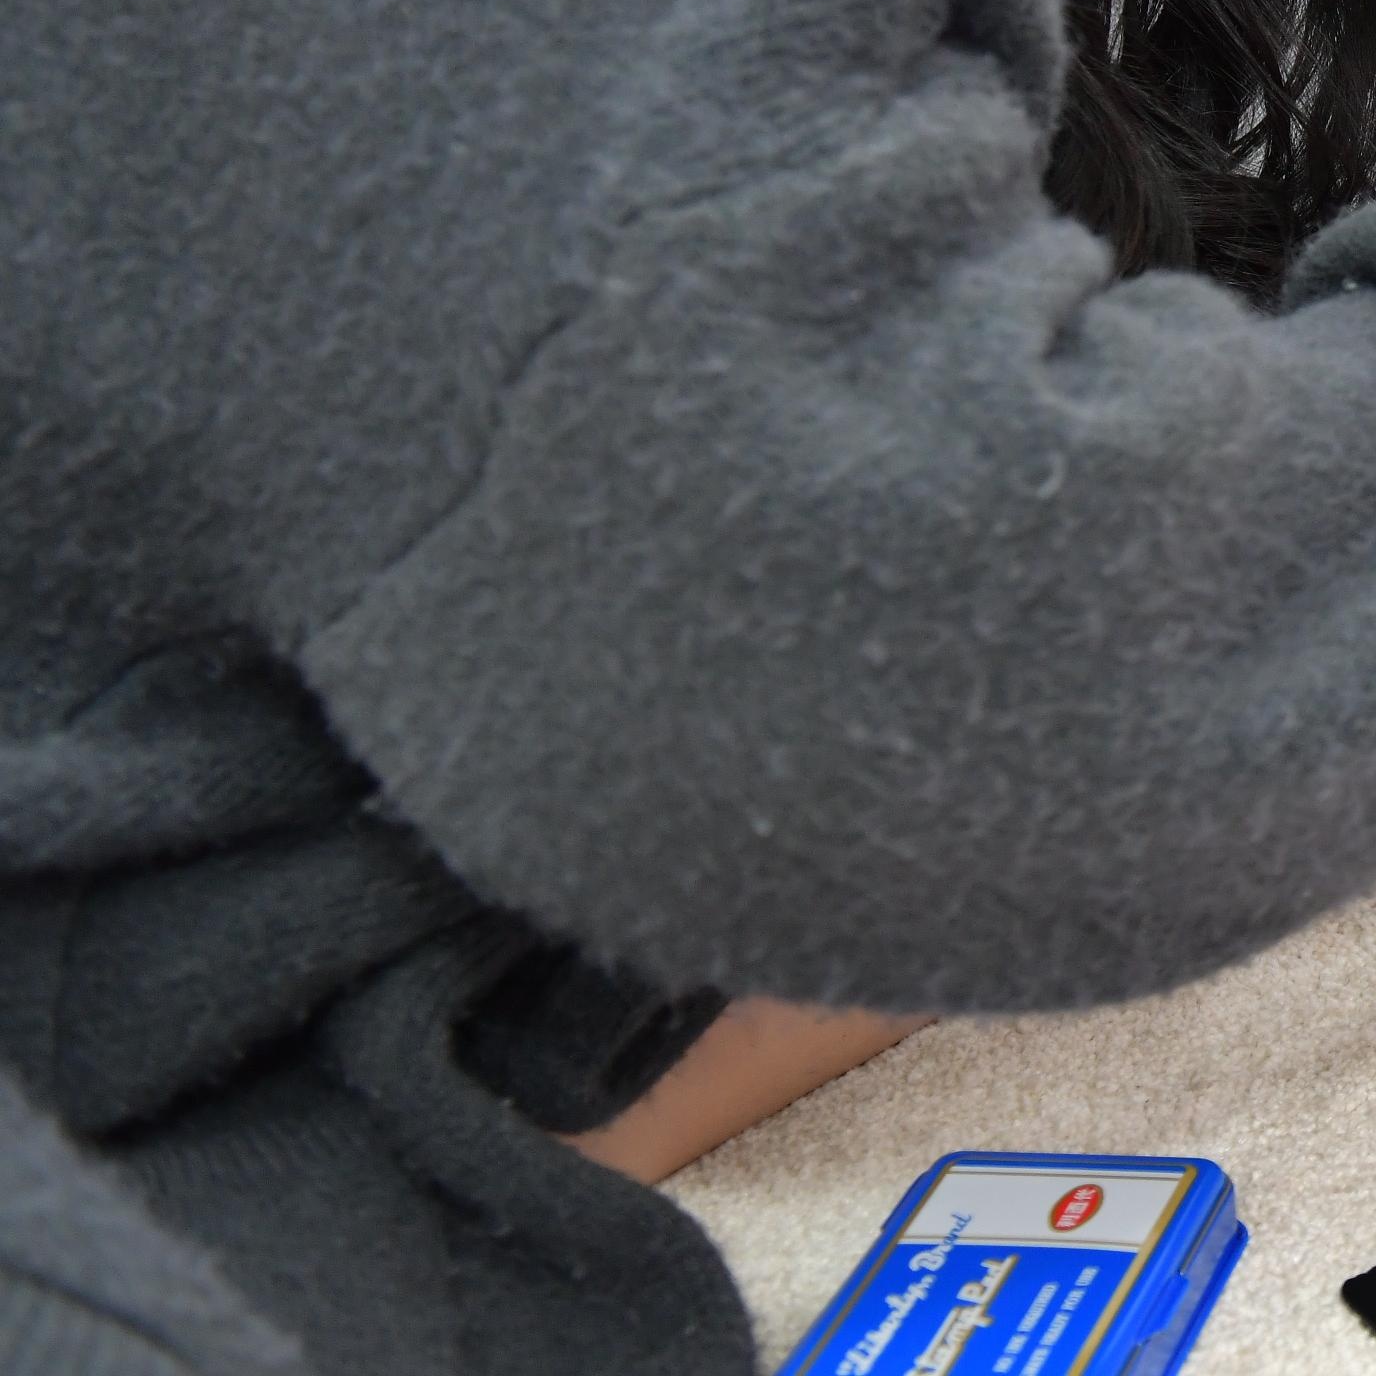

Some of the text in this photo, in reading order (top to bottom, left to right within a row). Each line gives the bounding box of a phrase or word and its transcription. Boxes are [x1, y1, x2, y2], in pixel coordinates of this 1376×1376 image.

[1056, 1185, 1098, 1230] 利百代
[908, 1211, 973, 1272] Brand
[955, 1254, 1020, 1306] Pad
